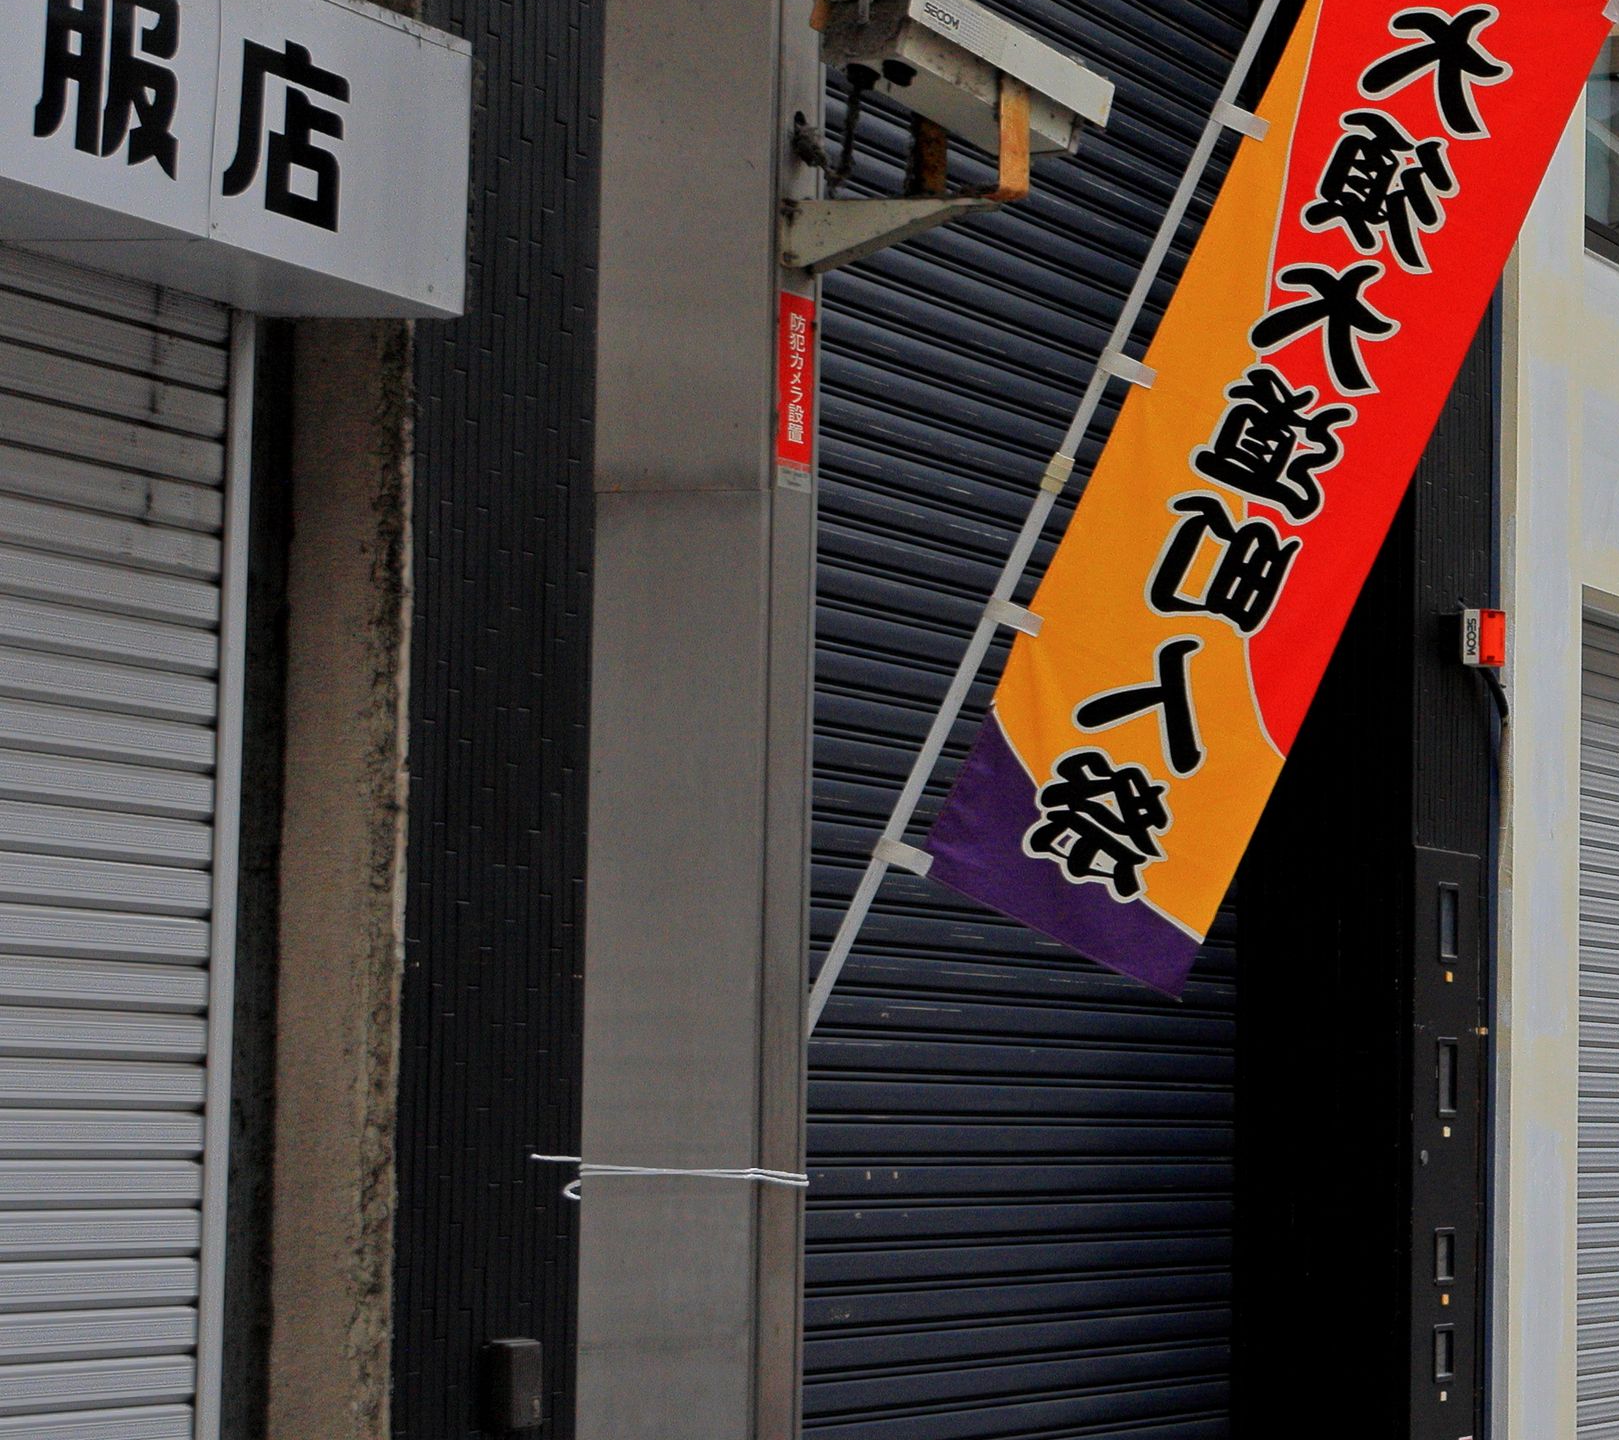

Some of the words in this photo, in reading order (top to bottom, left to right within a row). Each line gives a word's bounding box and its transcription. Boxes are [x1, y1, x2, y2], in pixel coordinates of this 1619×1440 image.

[922, 0, 962, 33] SECOM
[786, 311, 807, 446] 防犯カメラ設置
[1465, 617, 1478, 657] SECOM
